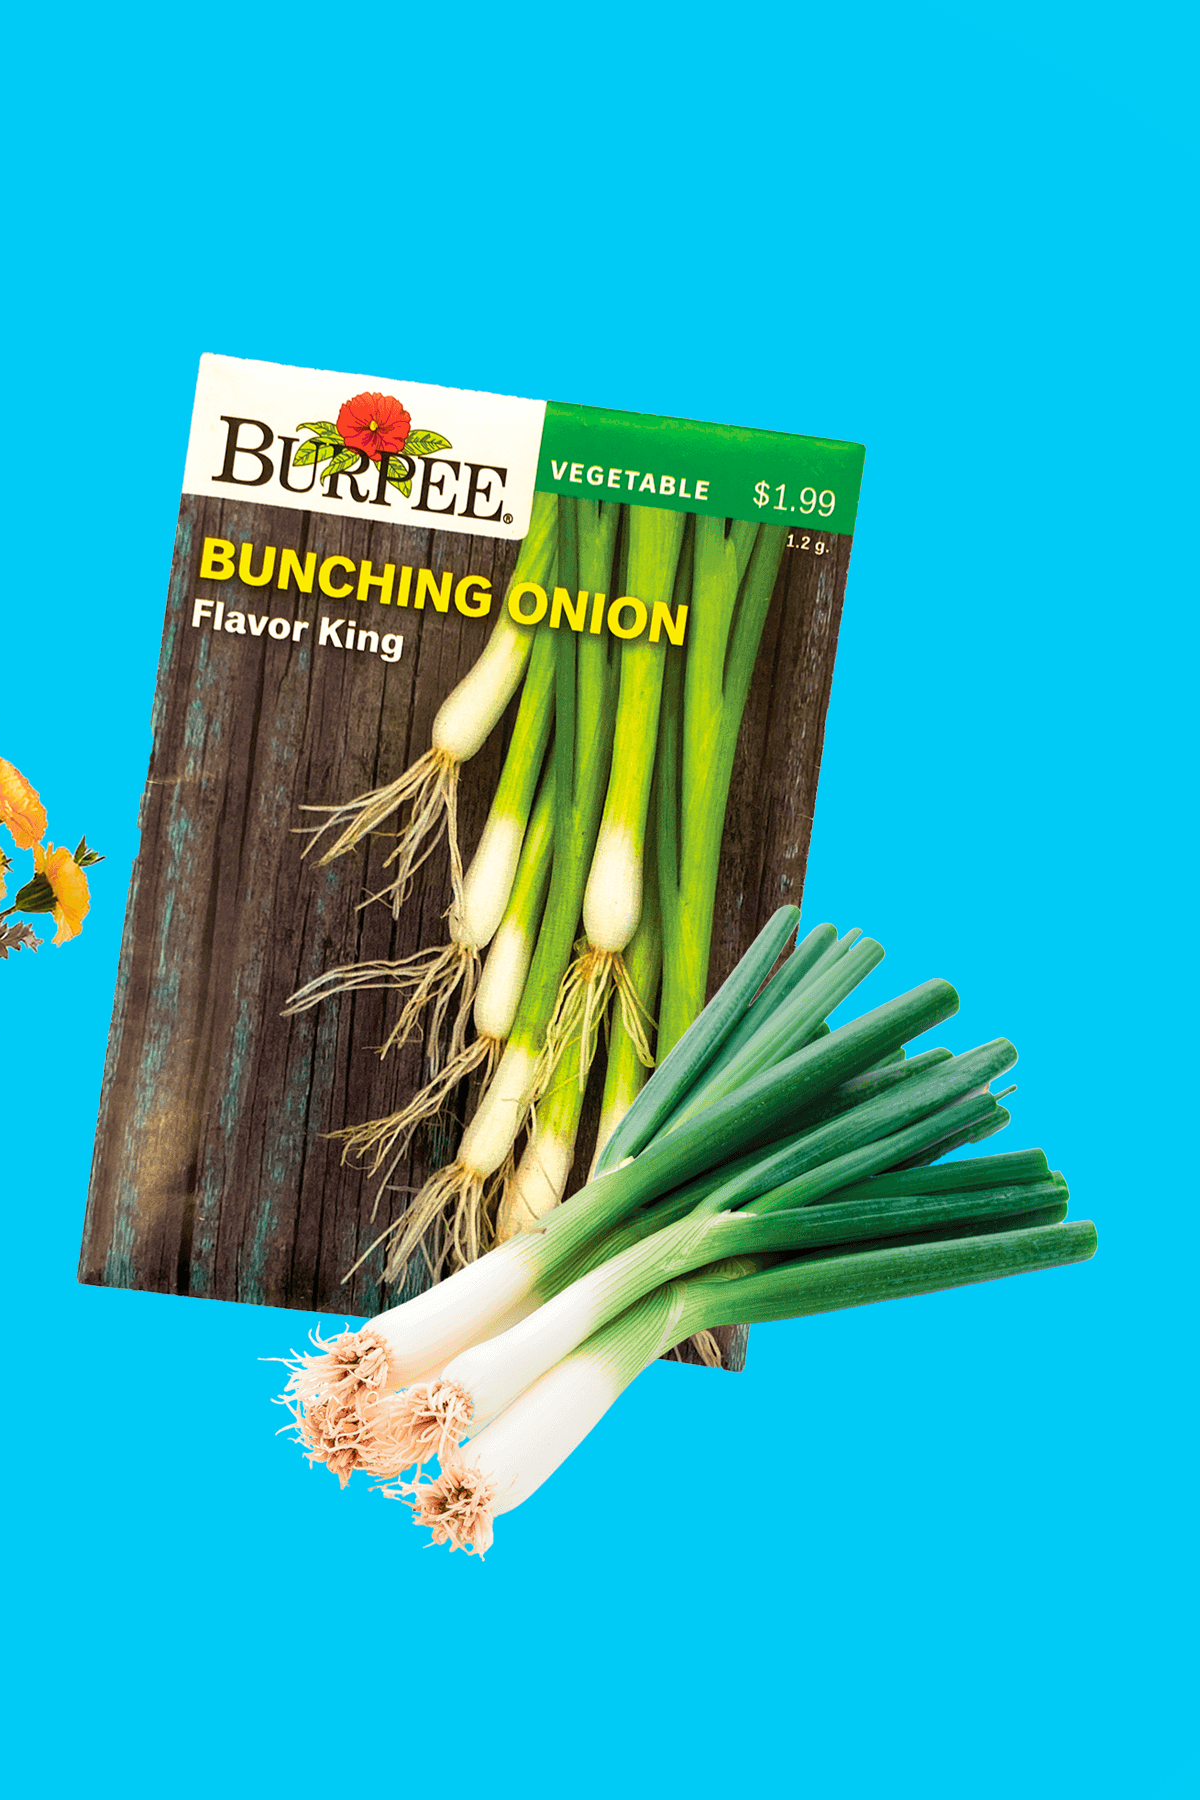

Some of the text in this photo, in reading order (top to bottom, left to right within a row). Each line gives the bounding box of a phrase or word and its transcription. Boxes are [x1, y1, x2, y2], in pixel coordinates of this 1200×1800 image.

[551, 460, 710, 501] VEGETABLE
[753, 480, 836, 517] $1.99
[786, 534, 830, 555] 1.2 g.
[199, 537, 689, 646] BUNCHING ONION
[191, 599, 405, 662] Flavor King
